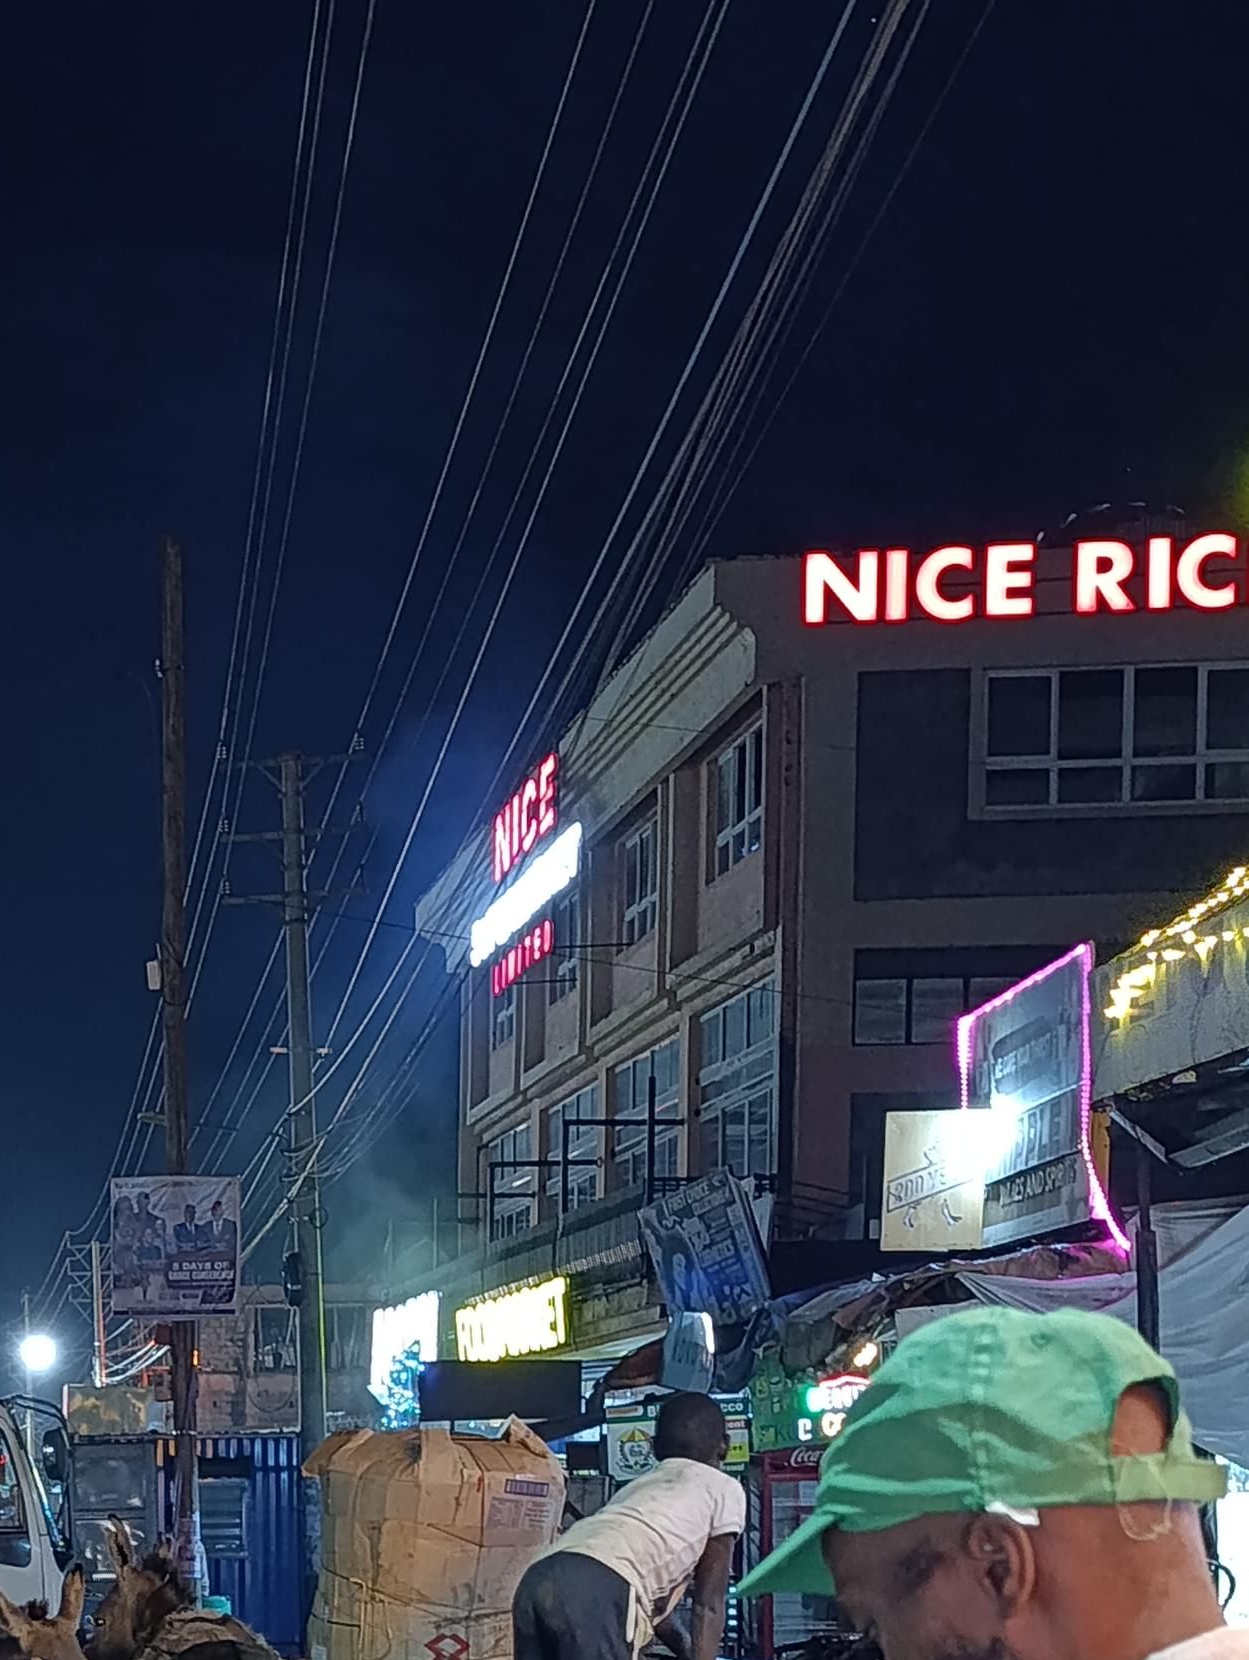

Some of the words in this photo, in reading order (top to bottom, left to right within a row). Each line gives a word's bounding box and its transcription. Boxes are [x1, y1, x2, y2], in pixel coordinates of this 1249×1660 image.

[803, 546, 1036, 625] NICE
[1075, 531, 1249, 613] RIC
[493, 752, 557, 885] NICE
[1024, 1167, 1045, 1199] AND
